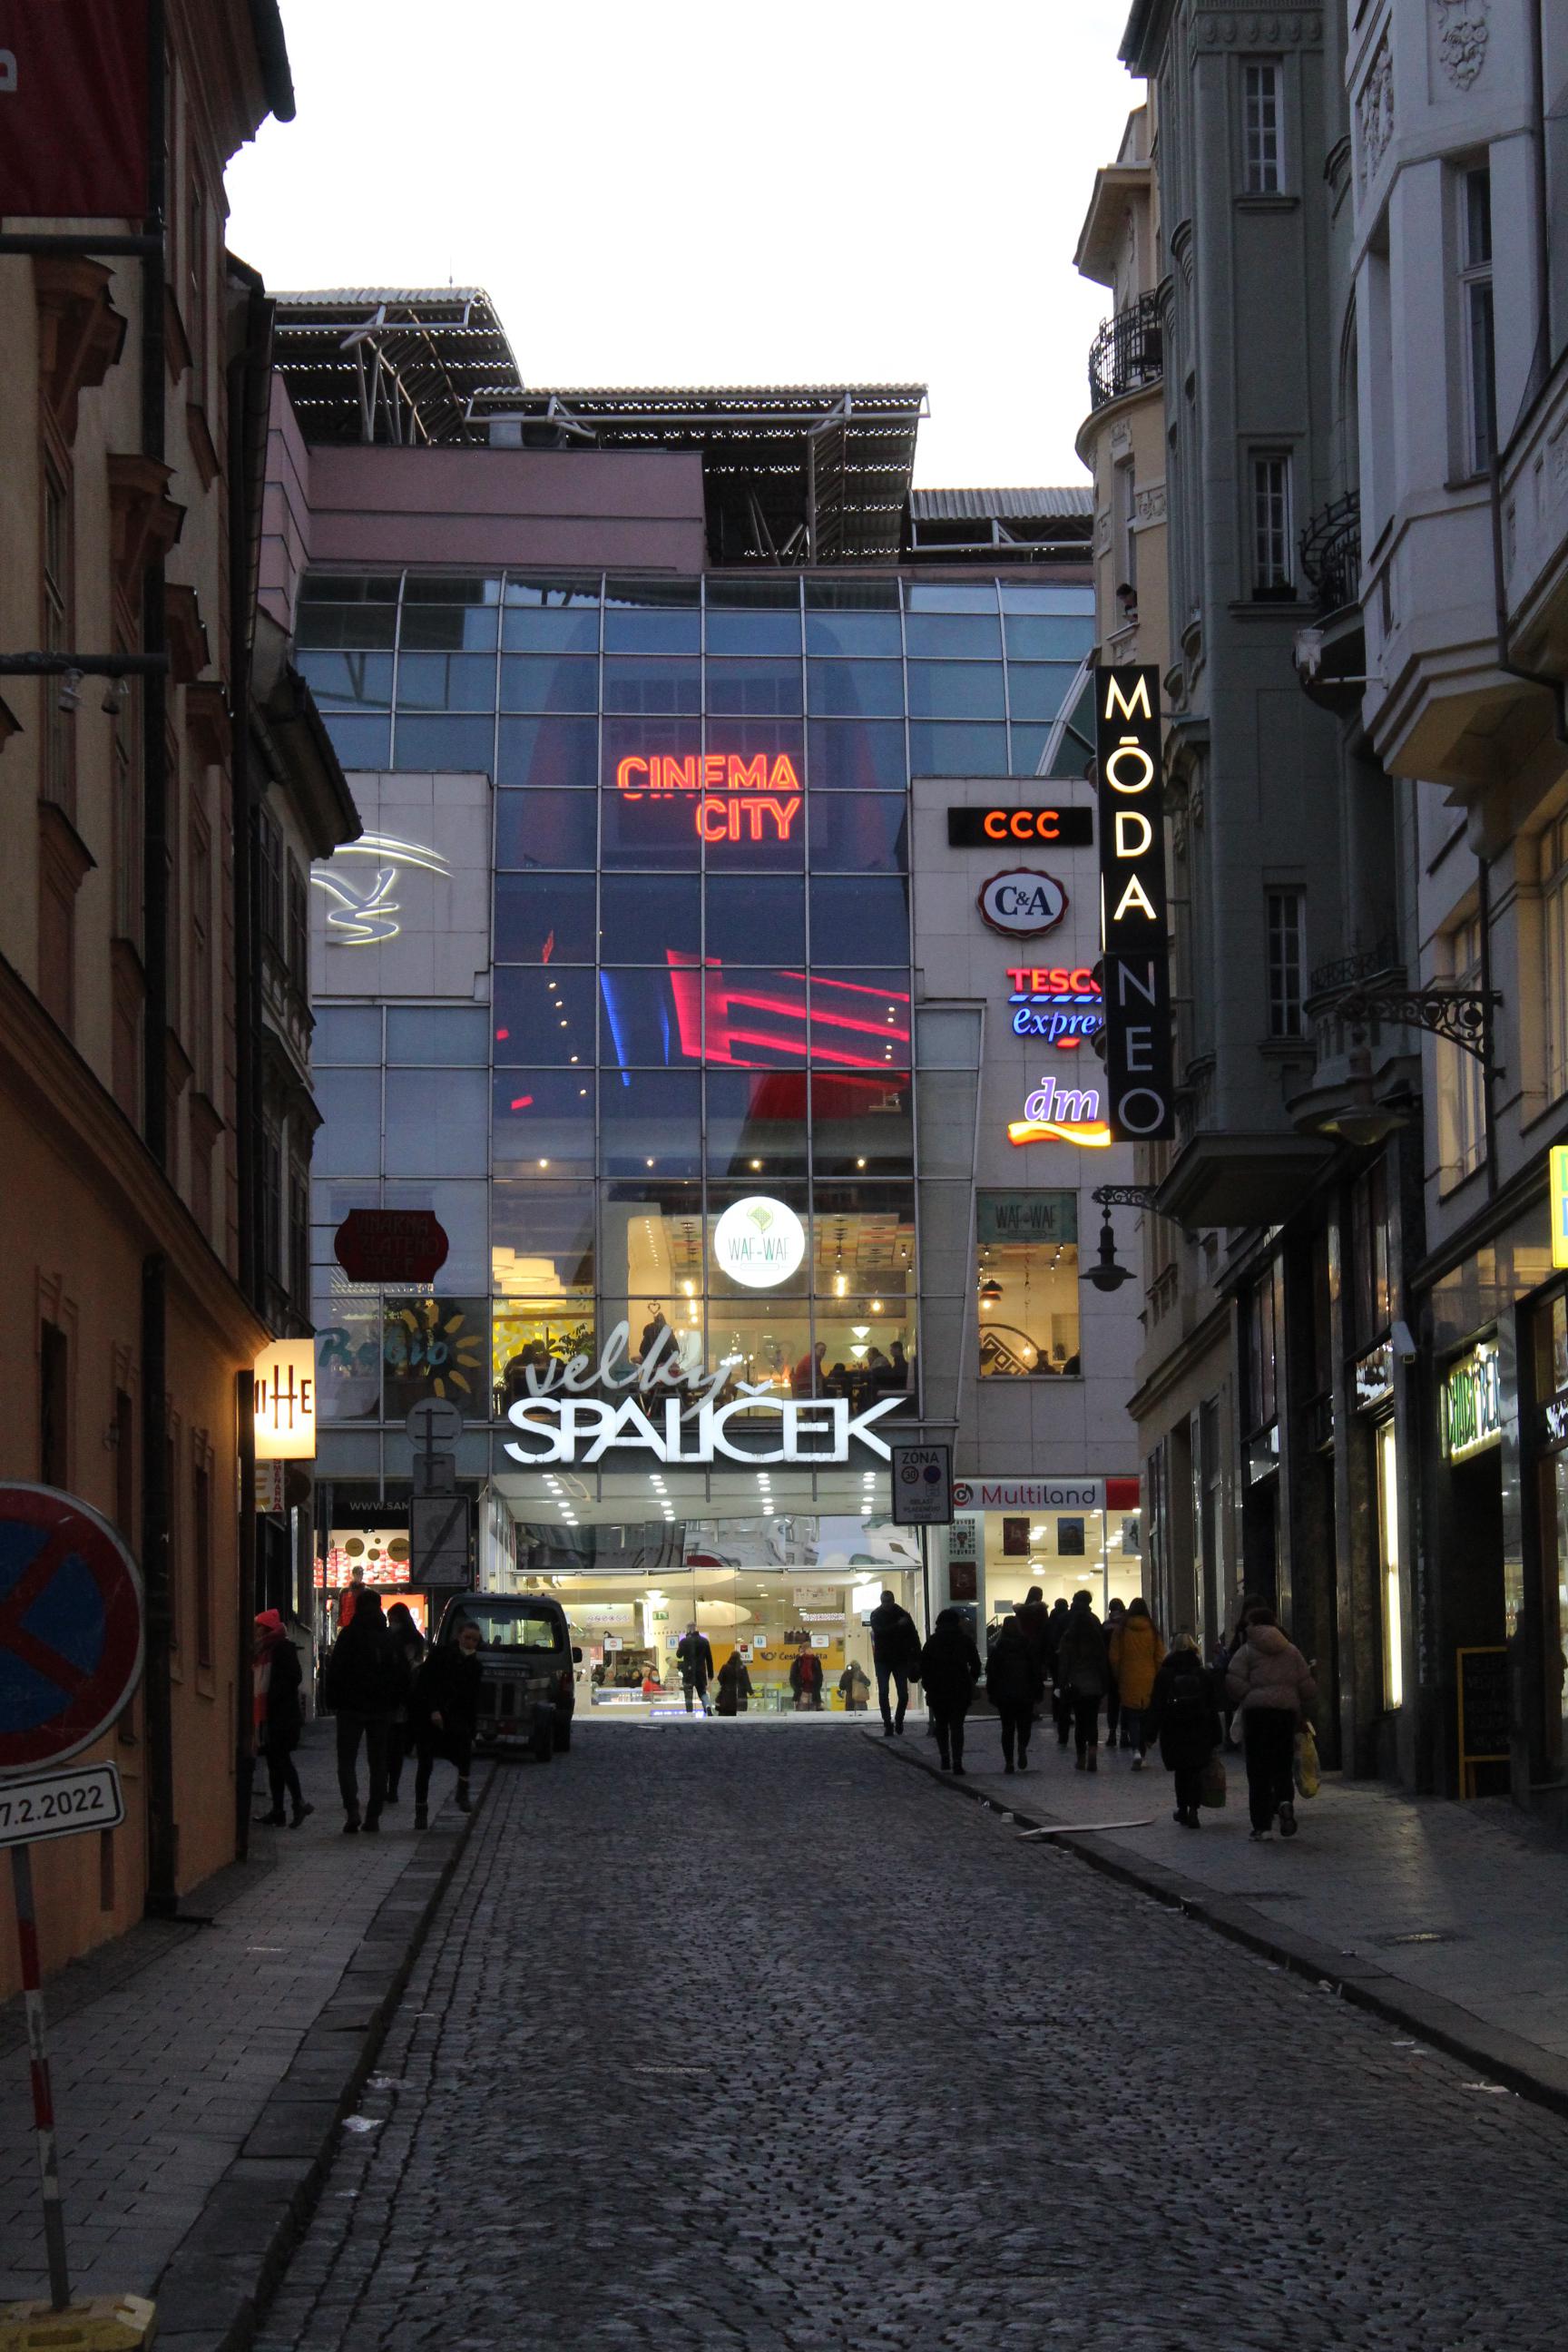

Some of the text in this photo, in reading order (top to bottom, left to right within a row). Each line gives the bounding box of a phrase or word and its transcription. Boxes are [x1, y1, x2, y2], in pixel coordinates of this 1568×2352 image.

[617, 754, 799, 799] CINEMA
[696, 797, 801, 841] CITY
[984, 811, 1060, 839] CCC
[995, 886, 1054, 916] C&A
[1024, 1076, 1100, 1122] dm
[982, 1485, 1095, 1504] Multiland
